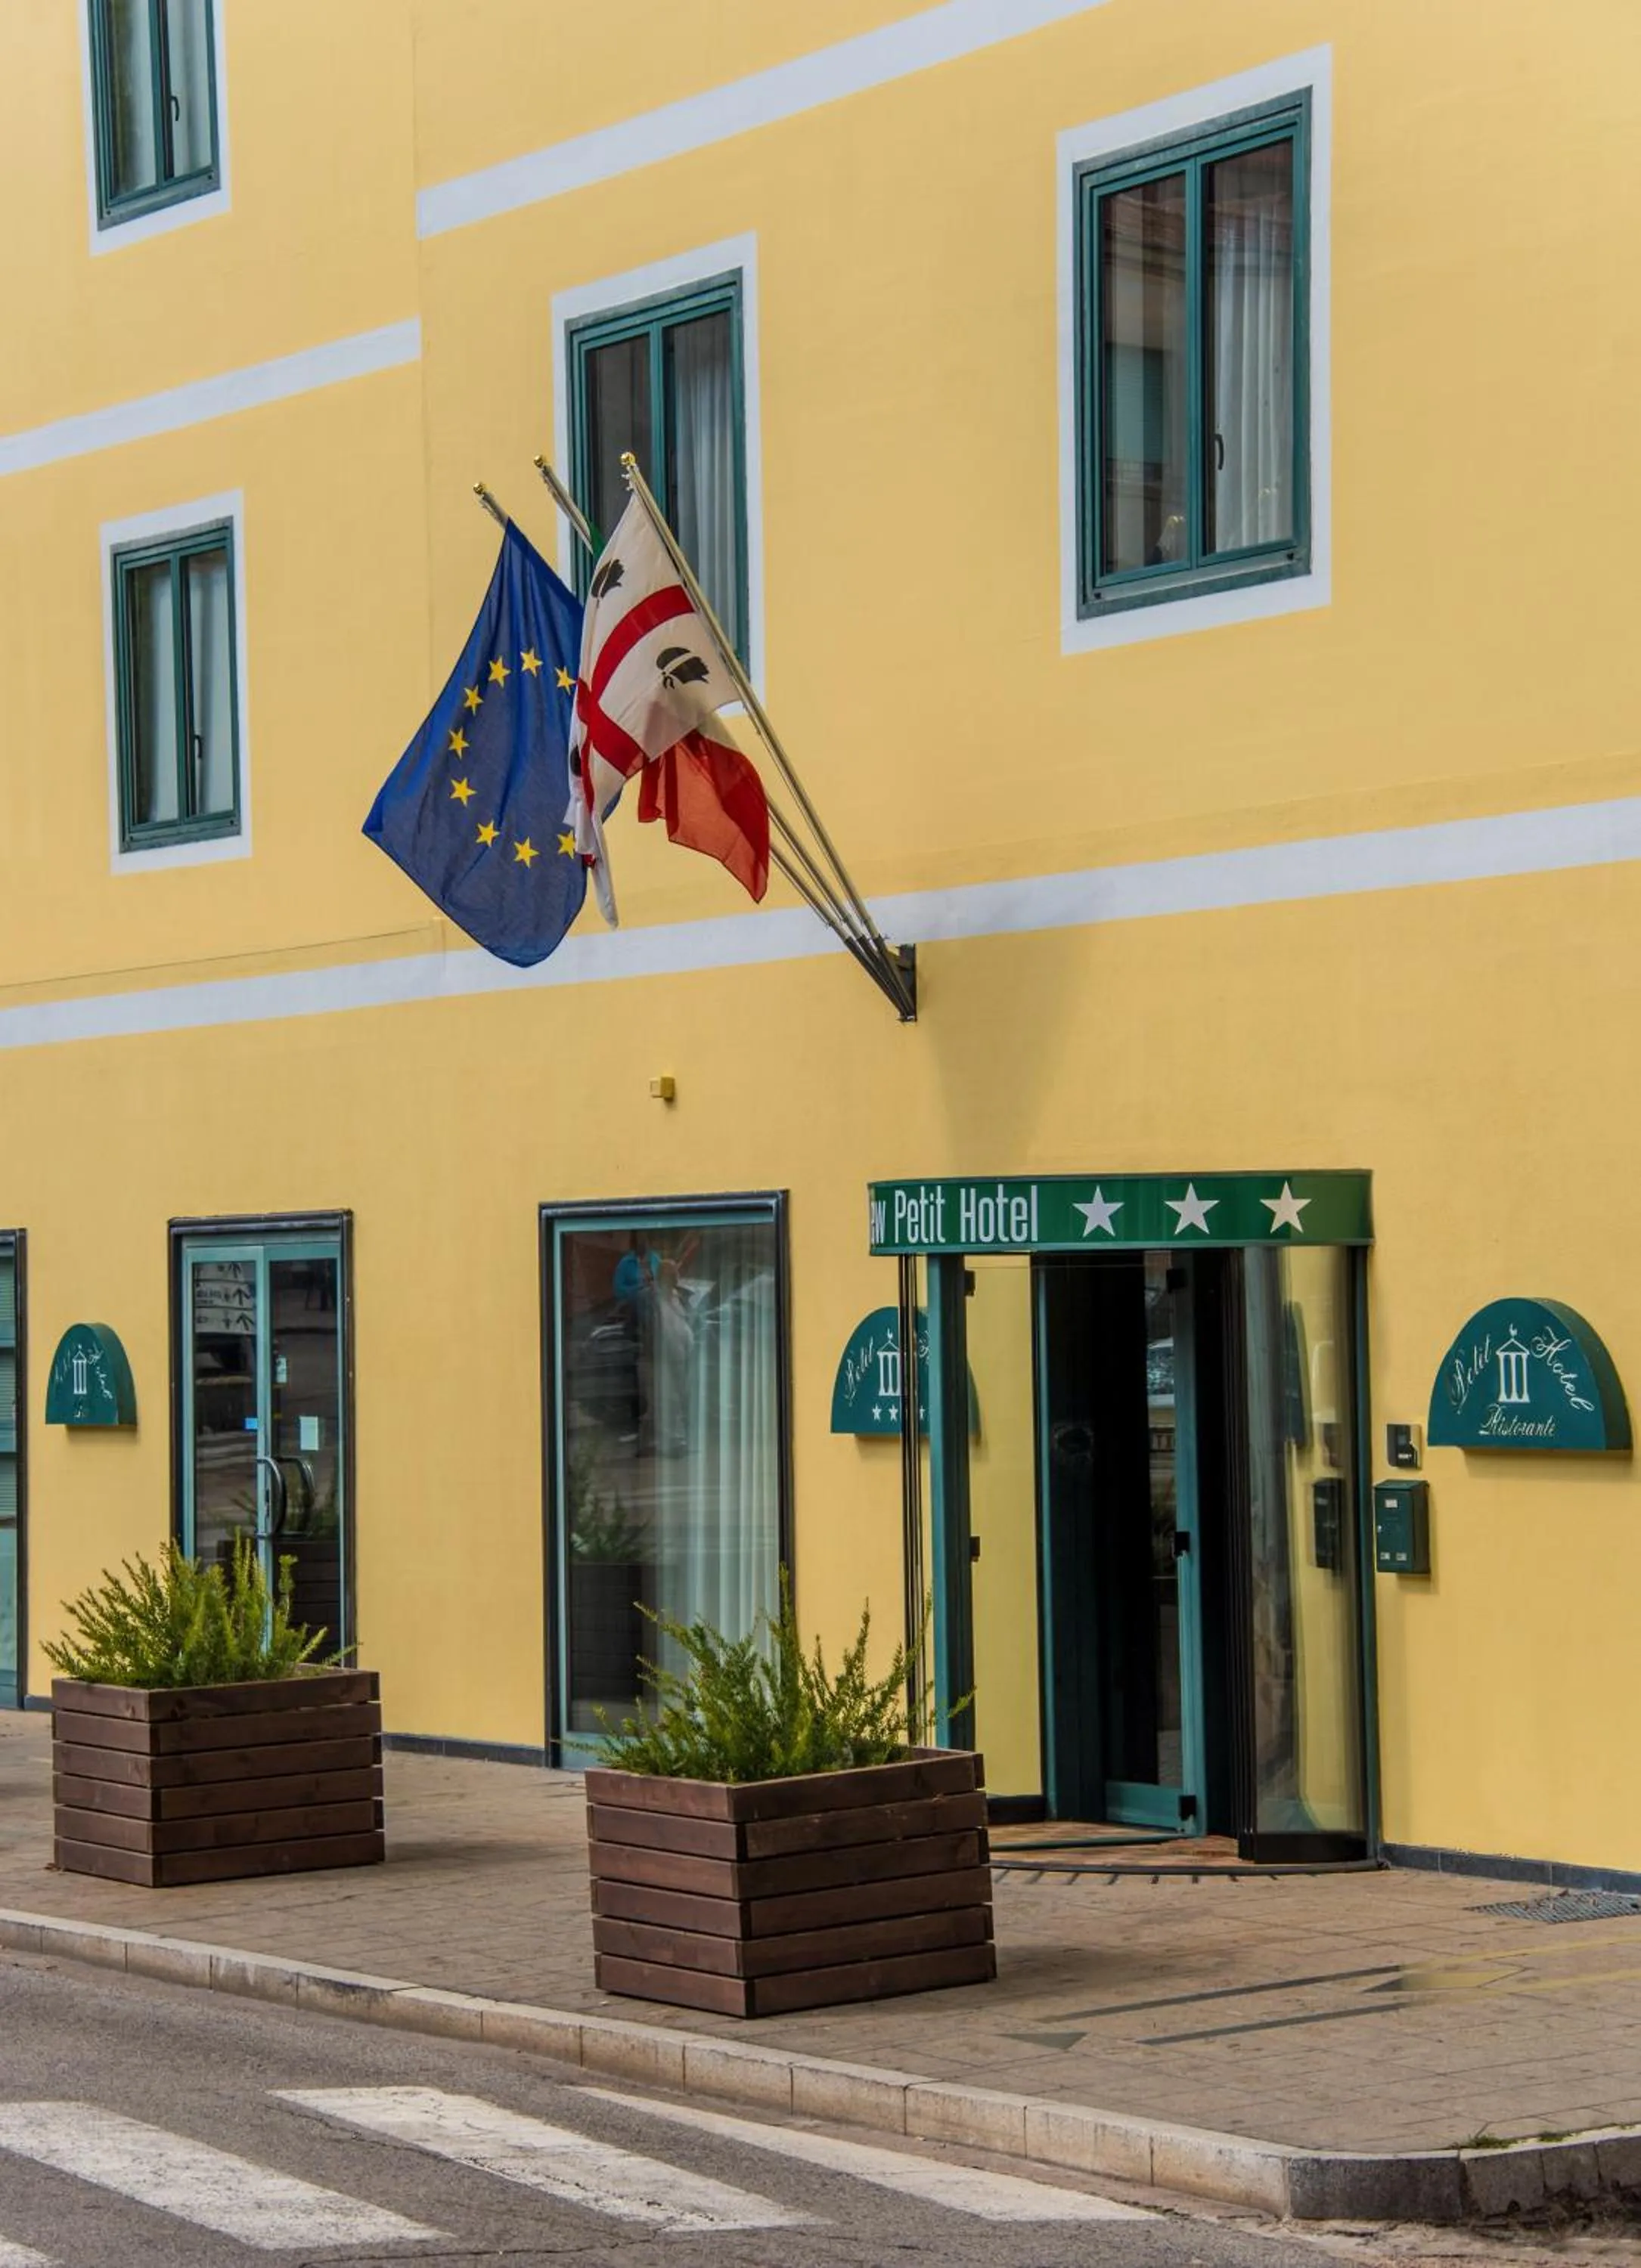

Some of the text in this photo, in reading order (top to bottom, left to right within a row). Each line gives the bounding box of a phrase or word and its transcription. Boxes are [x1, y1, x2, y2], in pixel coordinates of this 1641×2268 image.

[895, 1185, 945, 1244] Petit
[960, 1183, 1038, 1243] Hotel
[1530, 1325, 1596, 1412] Hotel
[1478, 1402, 1556, 1436] Ristorante
